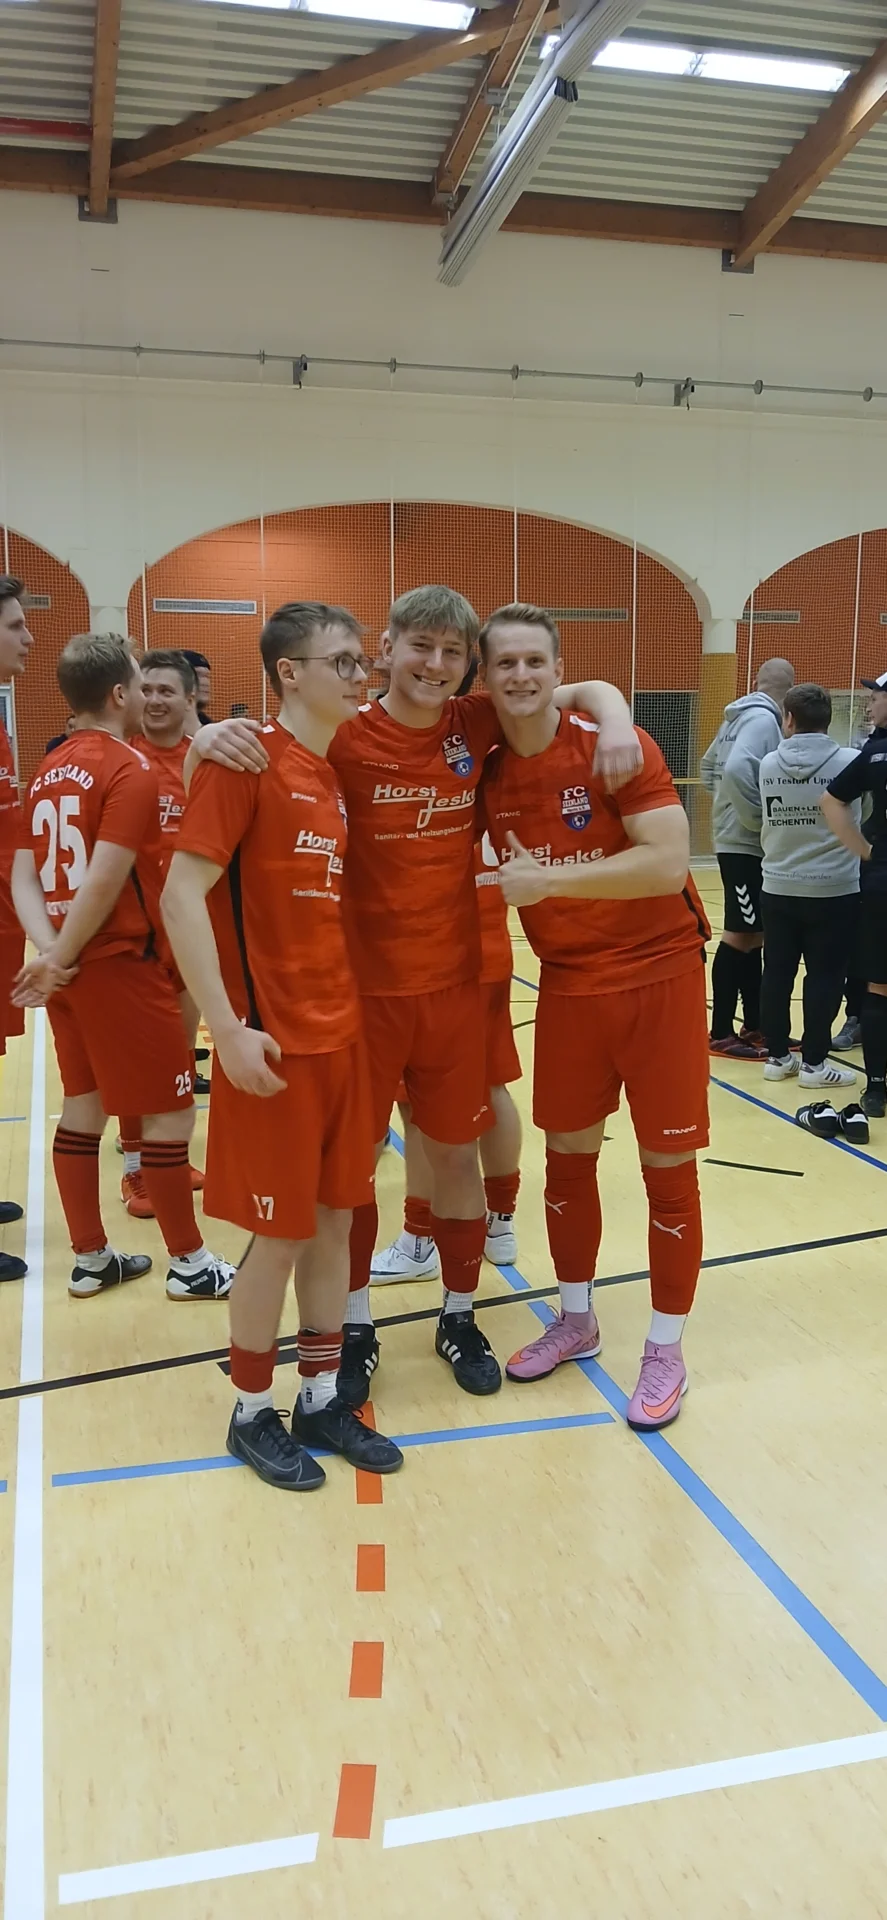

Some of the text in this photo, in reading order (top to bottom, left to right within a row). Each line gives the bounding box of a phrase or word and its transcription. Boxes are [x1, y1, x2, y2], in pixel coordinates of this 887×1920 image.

[442, 734, 463, 750] FC
[43, 763, 94, 790] SEELAND
[813, 776, 834, 787] Upa
[373, 783, 438, 799] Horst
[562, 785, 586, 800] FC
[768, 818, 816, 827] TECHENTIN
[32, 795, 88, 892] 25
[296, 829, 338, 851] Horst
[501, 842, 552, 861] Hrst
[175, 1069, 192, 1097] 25
